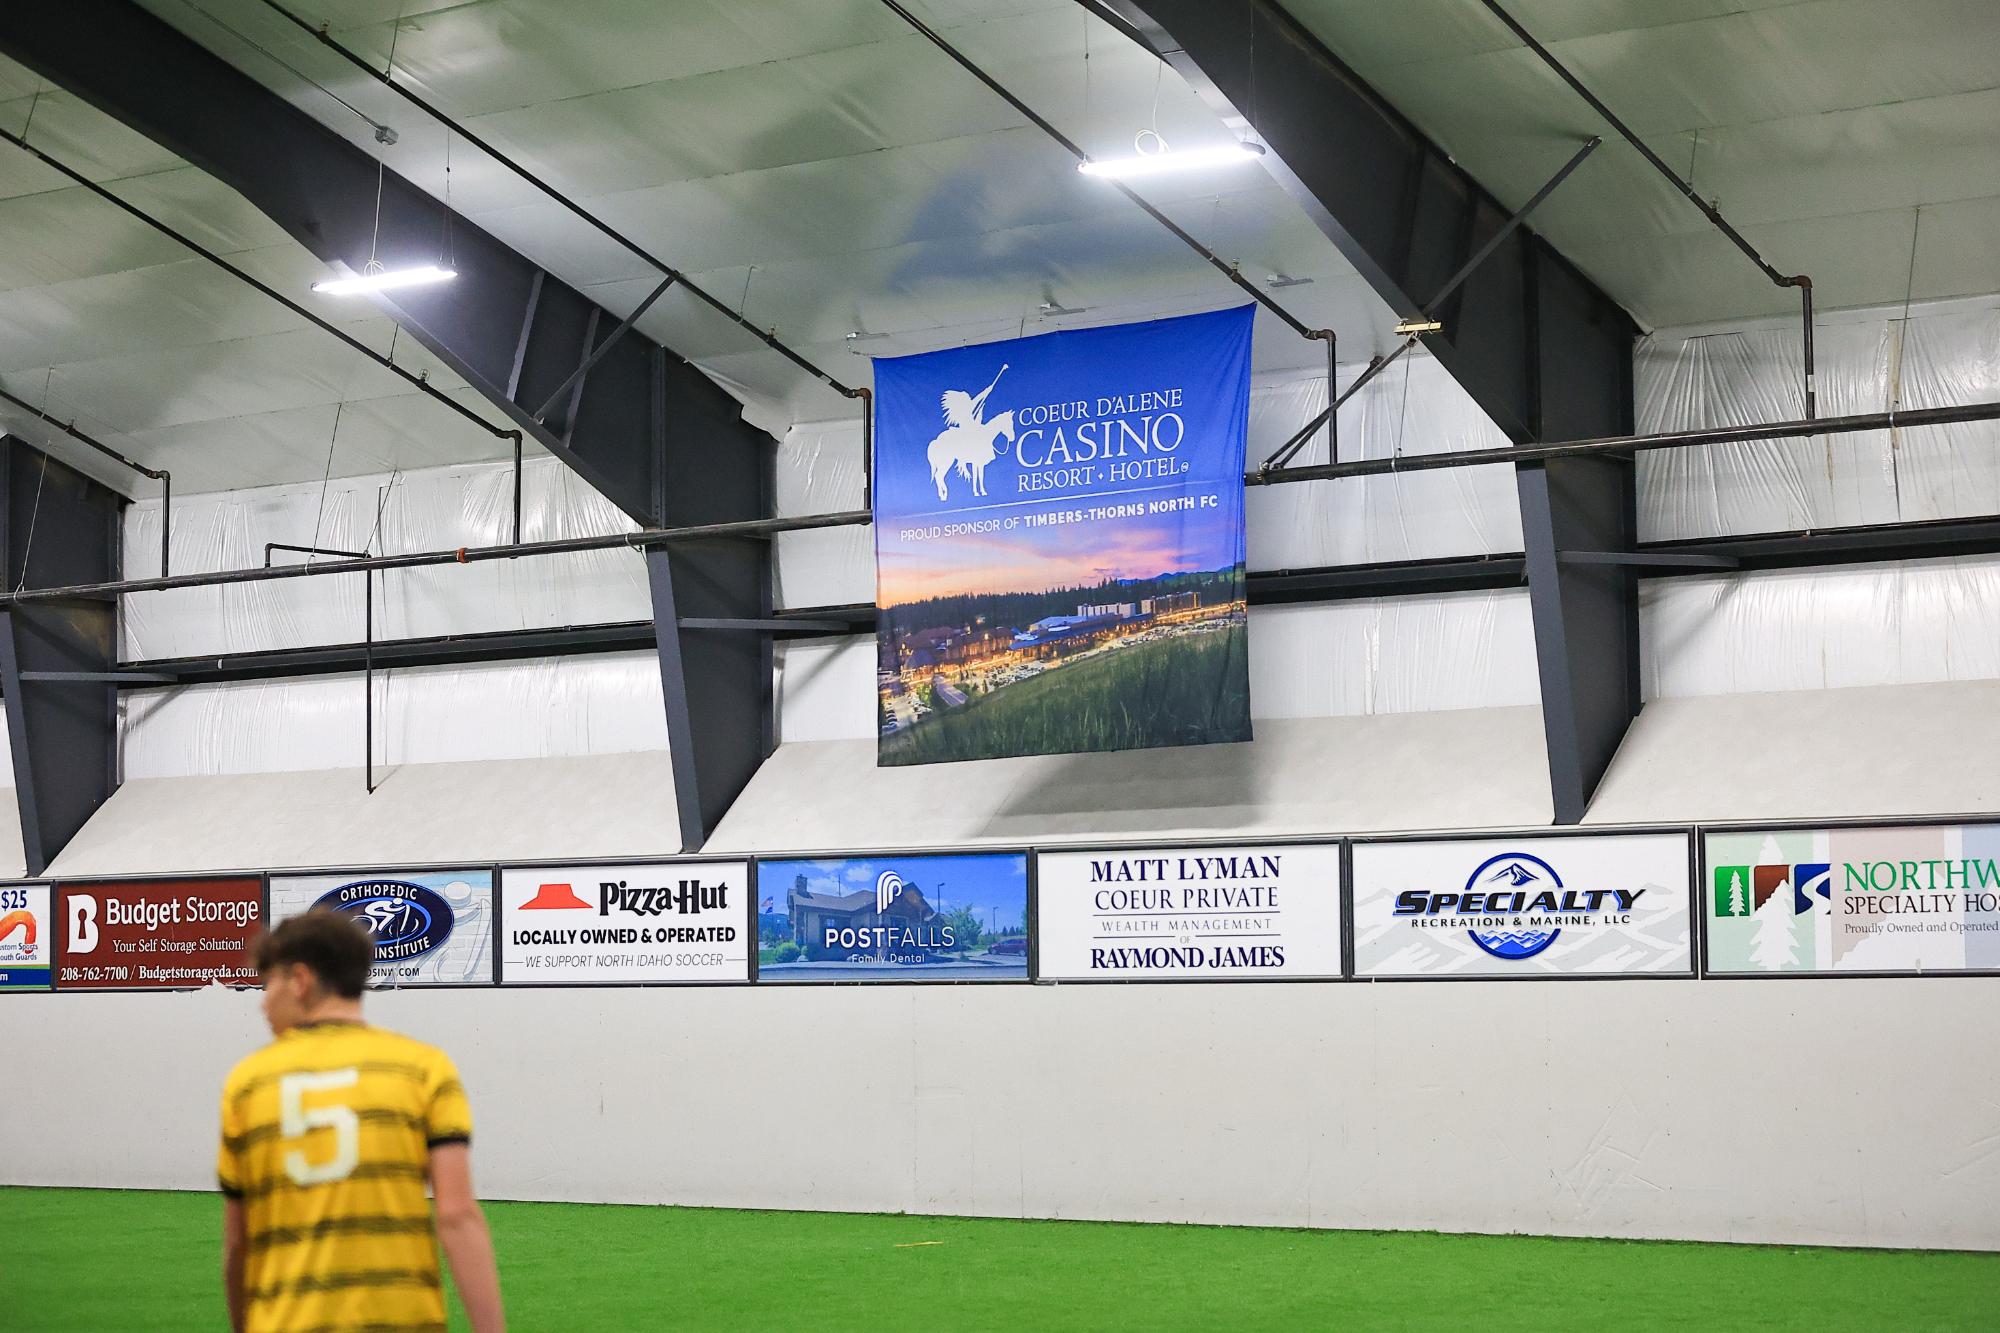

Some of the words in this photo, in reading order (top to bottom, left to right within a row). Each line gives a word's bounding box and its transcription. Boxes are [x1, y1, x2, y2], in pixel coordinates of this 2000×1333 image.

[1018, 399, 1091, 427] COEUR
[1096, 388, 1183, 417] D'ALENE
[1016, 412, 1186, 468] CASINO
[1017, 466, 1096, 493] RESORT
[900, 526, 941, 542] PROUD
[944, 520, 1001, 537] SPONSOR
[1003, 516, 1020, 531] OF
[1023, 502, 1145, 528] TIMBERS-THORNS
[1149, 496, 1195, 516] NORTH
[1200, 494, 1219, 509] FC
[1090, 859, 1169, 882] MATT
[1177, 856, 1282, 881] LYMAN
[1844, 858, 2000, 892] NORTHW
[1, 890, 27, 911] $25
[340, 884, 418, 901] ORTHOPEDIC
[599, 880, 673, 916] Pizza
[673, 880, 728, 914] Hut
[1095, 889, 1175, 910] COEUR
[1183, 887, 1279, 909] PRIVATE
[1392, 888, 1647, 916] SPECIALTY
[106, 896, 181, 930] Budget
[186, 896, 259, 927] Storage
[1844, 894, 1956, 915] SPECIALTY
[1964, 893, 2000, 912] HO
[1102, 920, 1159, 932] WEALTH
[1168, 918, 1272, 931] MANAGEMENT
[1411, 916, 1505, 928] RECREATION
[1513, 916, 1522, 926] &
[1530, 915, 1596, 926] MARINE,
[1604, 914, 1631, 925] LLC
[1844, 922, 1884, 935] Proudly
[1886, 922, 1924, 933] Owned
[1926, 922, 1947, 932] and
[1950, 921, 1999, 934] Operated
[112, 939, 136, 953] Your
[138, 938, 157, 952] Self
[160, 937, 197, 954] Storage
[199, 937, 244, 951] Solution!
[513, 929, 577, 945] LOCALLY
[580, 928, 638, 944] OWNED
[640, 928, 652, 943] &
[655, 926, 736, 943] OPERATED
[1179, 935, 1191, 944] OF
[15, 952, 37, 961] Guards
[18, 942, 38, 952] Sports
[374, 936, 430, 959] INSTITUTE
[1090, 947, 1204, 969] RAYMOND
[1208, 946, 1285, 968] JAMES
[525, 956, 542, 968] WE
[544, 955, 593, 967] SUPPORT
[595, 954, 634, 967] NORTH
[636, 954, 673, 967] IDAHO
[675, 953, 724, 966] SOCCER
[851, 953, 886, 965] Family
[890, 953, 925, 963] Dental
[60, 965, 128, 981] 208-762-7700
[280, 1067, 360, 1187] 5
